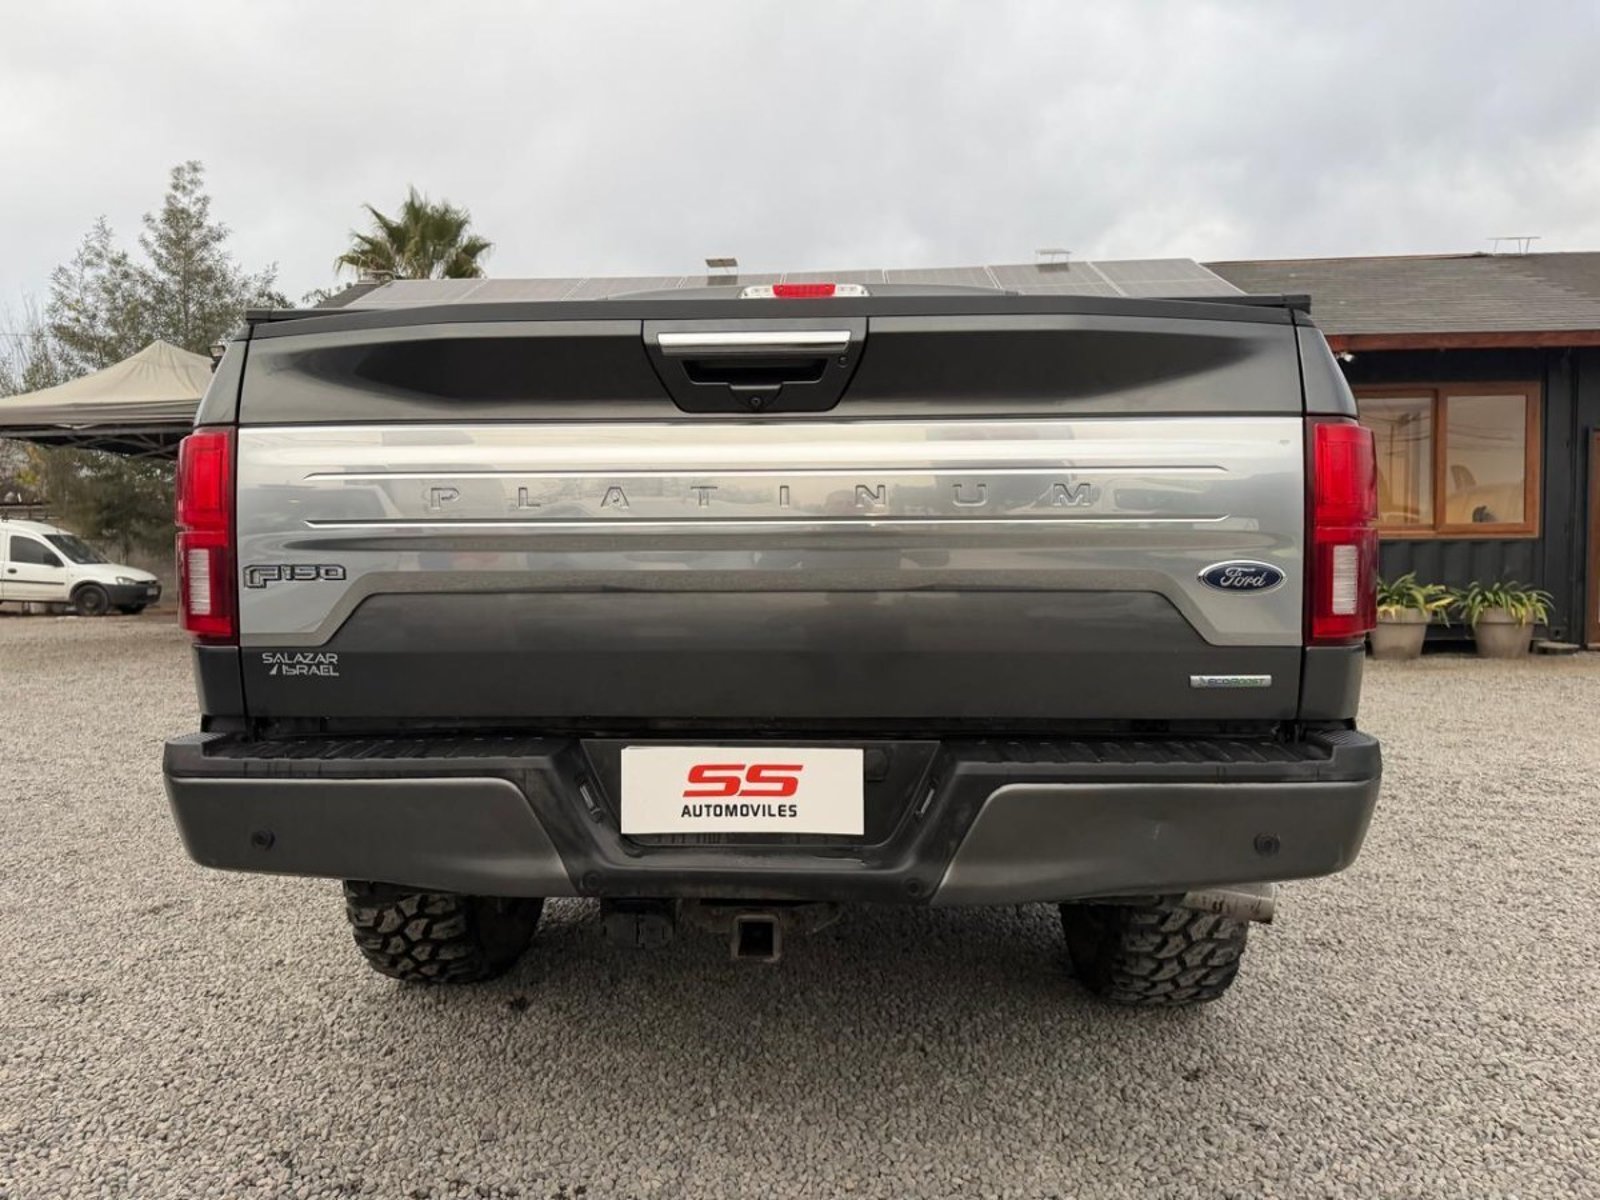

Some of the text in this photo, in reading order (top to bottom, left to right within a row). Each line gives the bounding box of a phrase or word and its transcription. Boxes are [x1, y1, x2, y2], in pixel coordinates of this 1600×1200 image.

[431, 483, 1092, 508] PLATINUM
[1220, 567, 1267, 586] Ford
[262, 652, 339, 664] SALAZAR
[682, 764, 803, 797] SS
[681, 804, 798, 817] AUTOMOVILES
